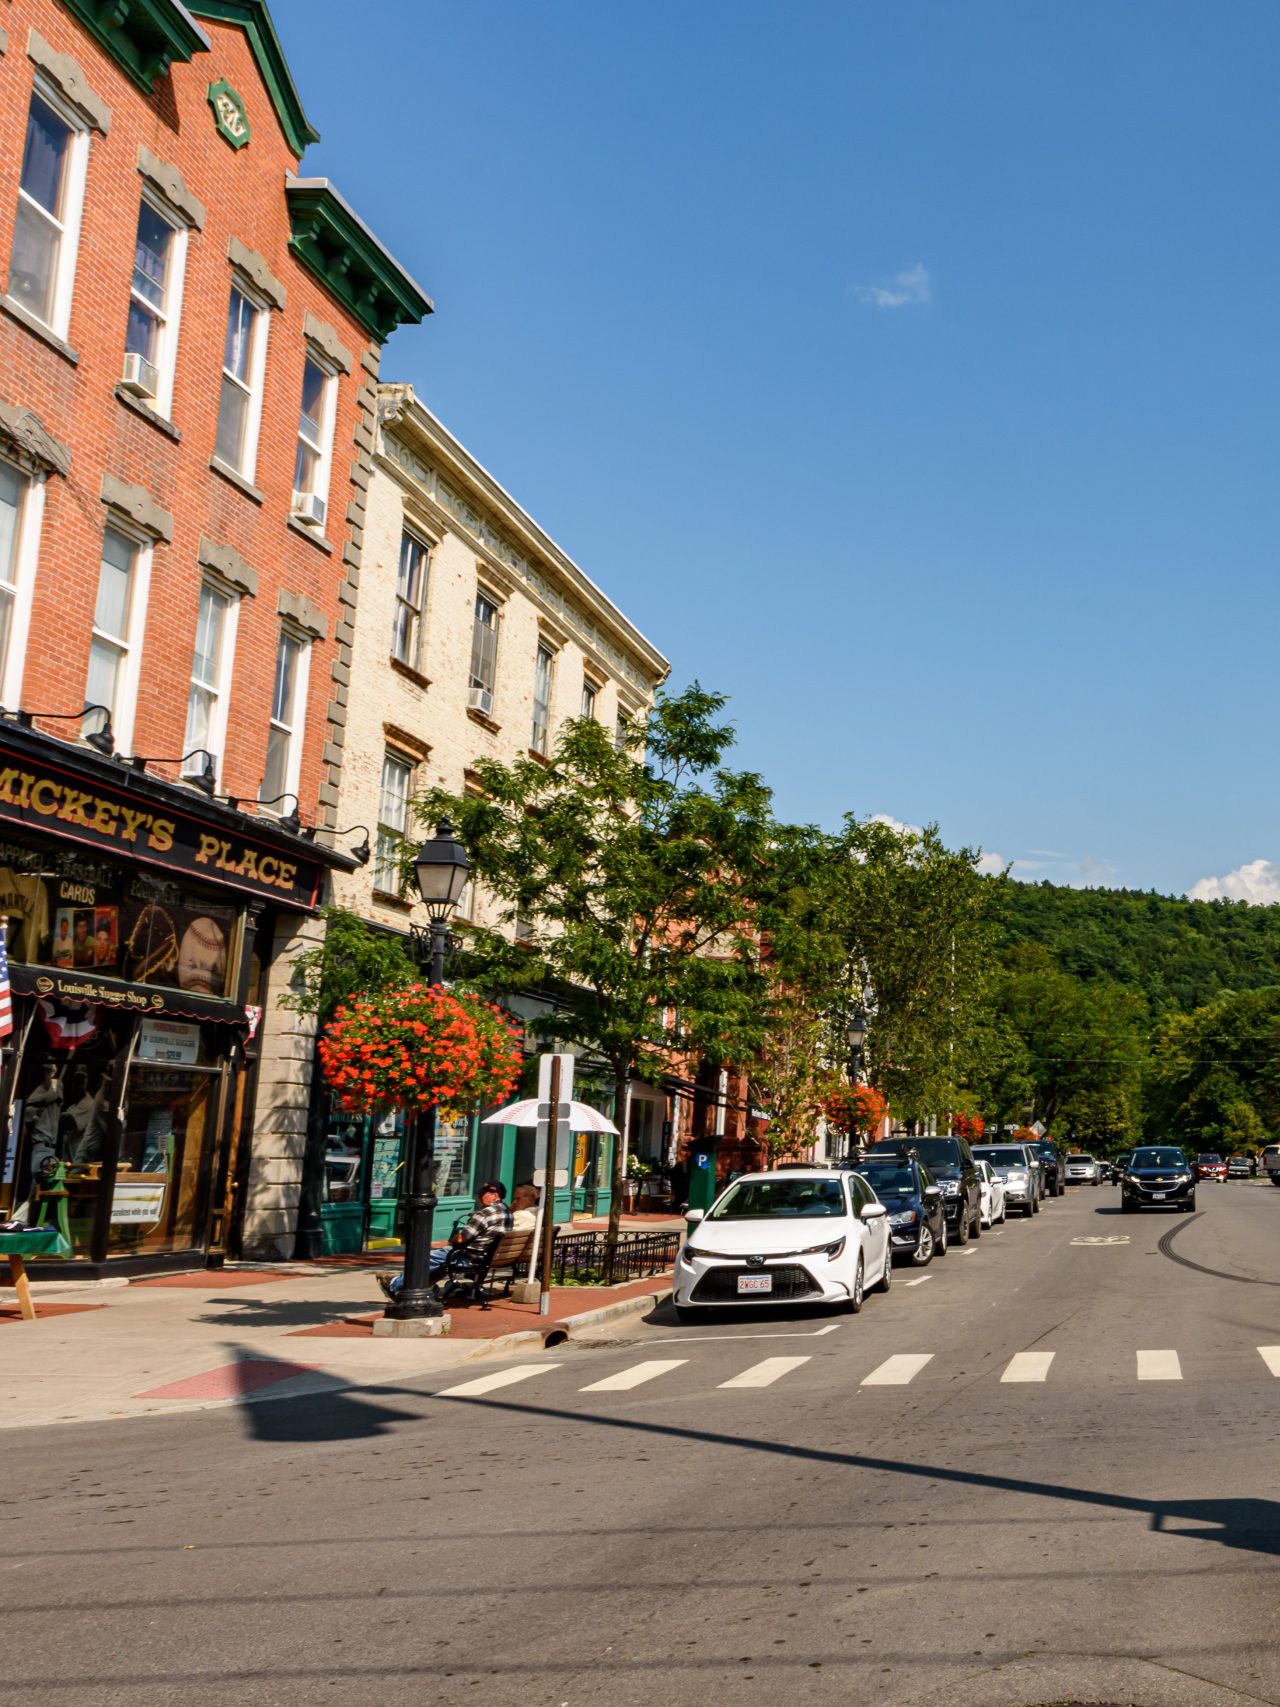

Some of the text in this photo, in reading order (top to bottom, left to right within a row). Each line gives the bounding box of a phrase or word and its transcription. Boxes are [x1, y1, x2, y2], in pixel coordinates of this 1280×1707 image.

[195, 832, 297, 890] PLACE
[60, 880, 96, 905] CARDS
[58, 979, 98, 996] Louisville
[98, 986, 127, 1002] Slugger
[127, 990, 147, 1007] Shop
[698, 1154, 707, 1167] P
[739, 1279, 769, 1289] 2WGC 65
